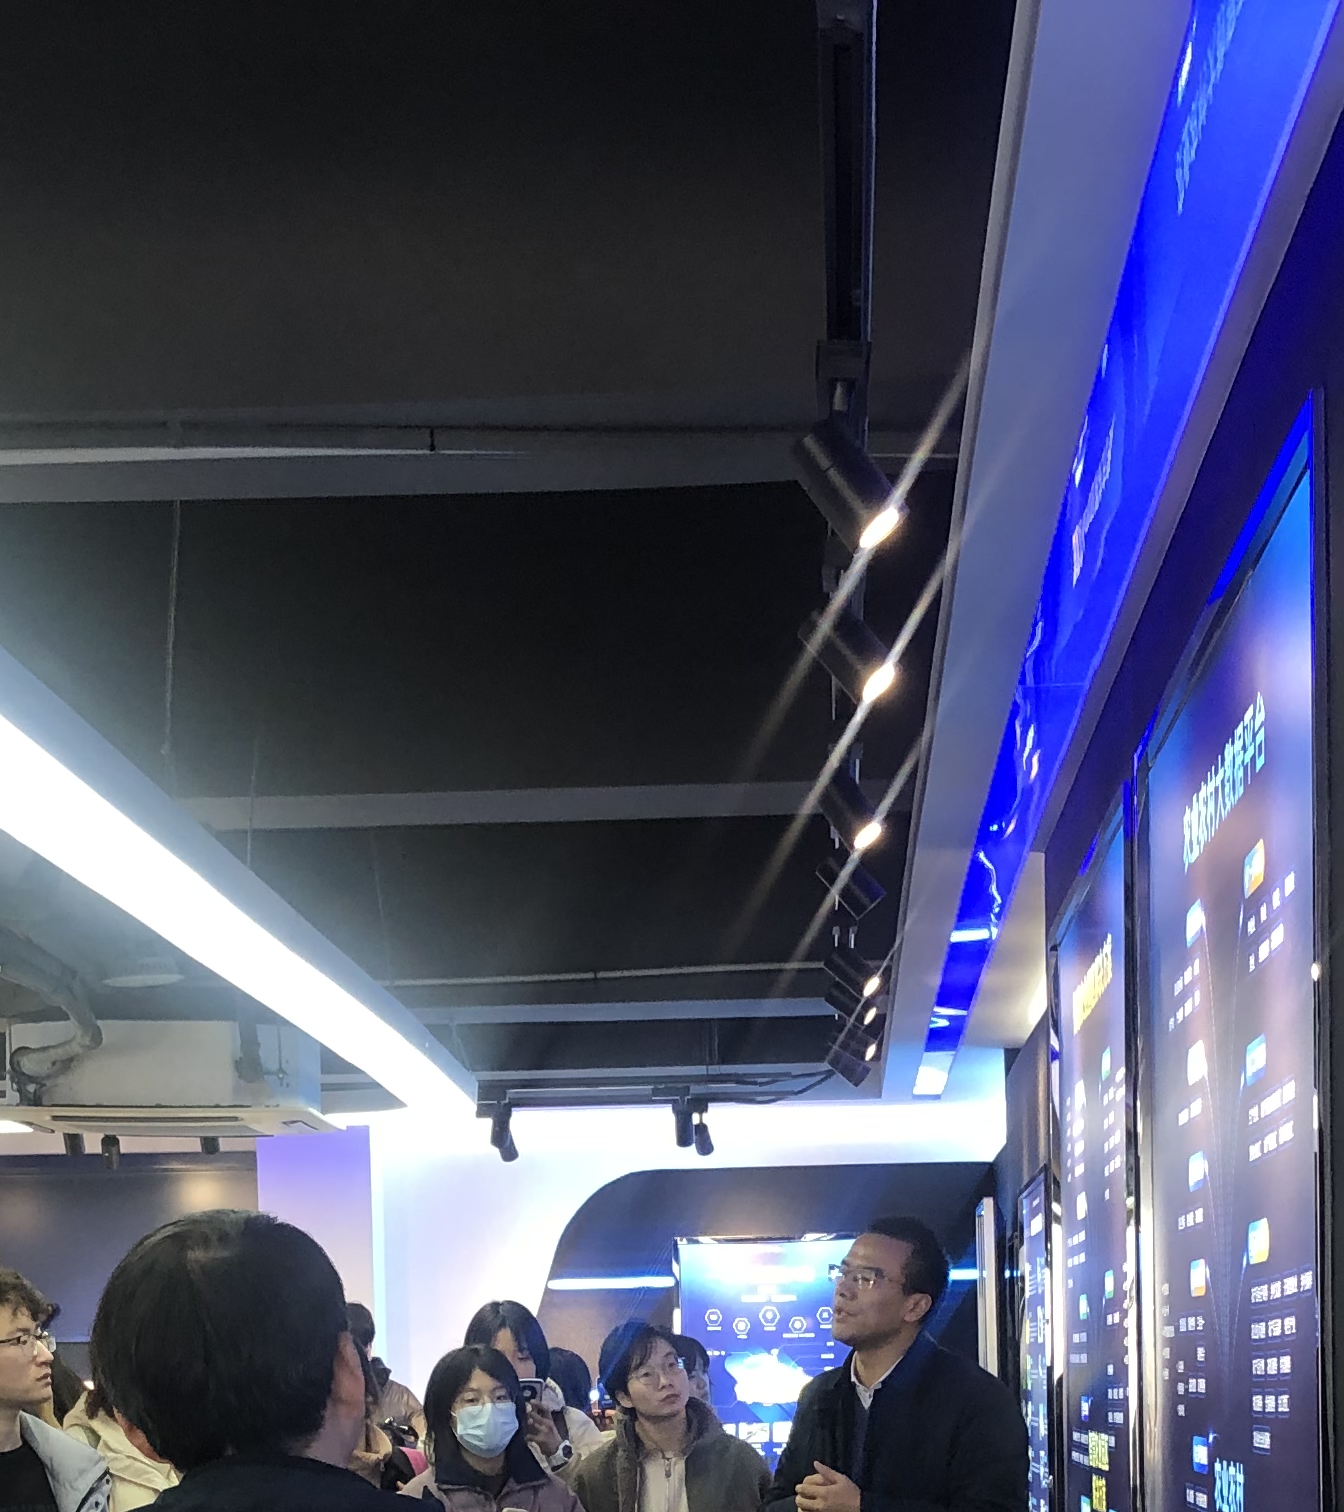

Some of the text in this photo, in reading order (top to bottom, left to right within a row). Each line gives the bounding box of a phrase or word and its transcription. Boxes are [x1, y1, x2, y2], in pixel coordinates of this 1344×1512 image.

[1182, 691, 1266, 874] 农业农村大数据平台
